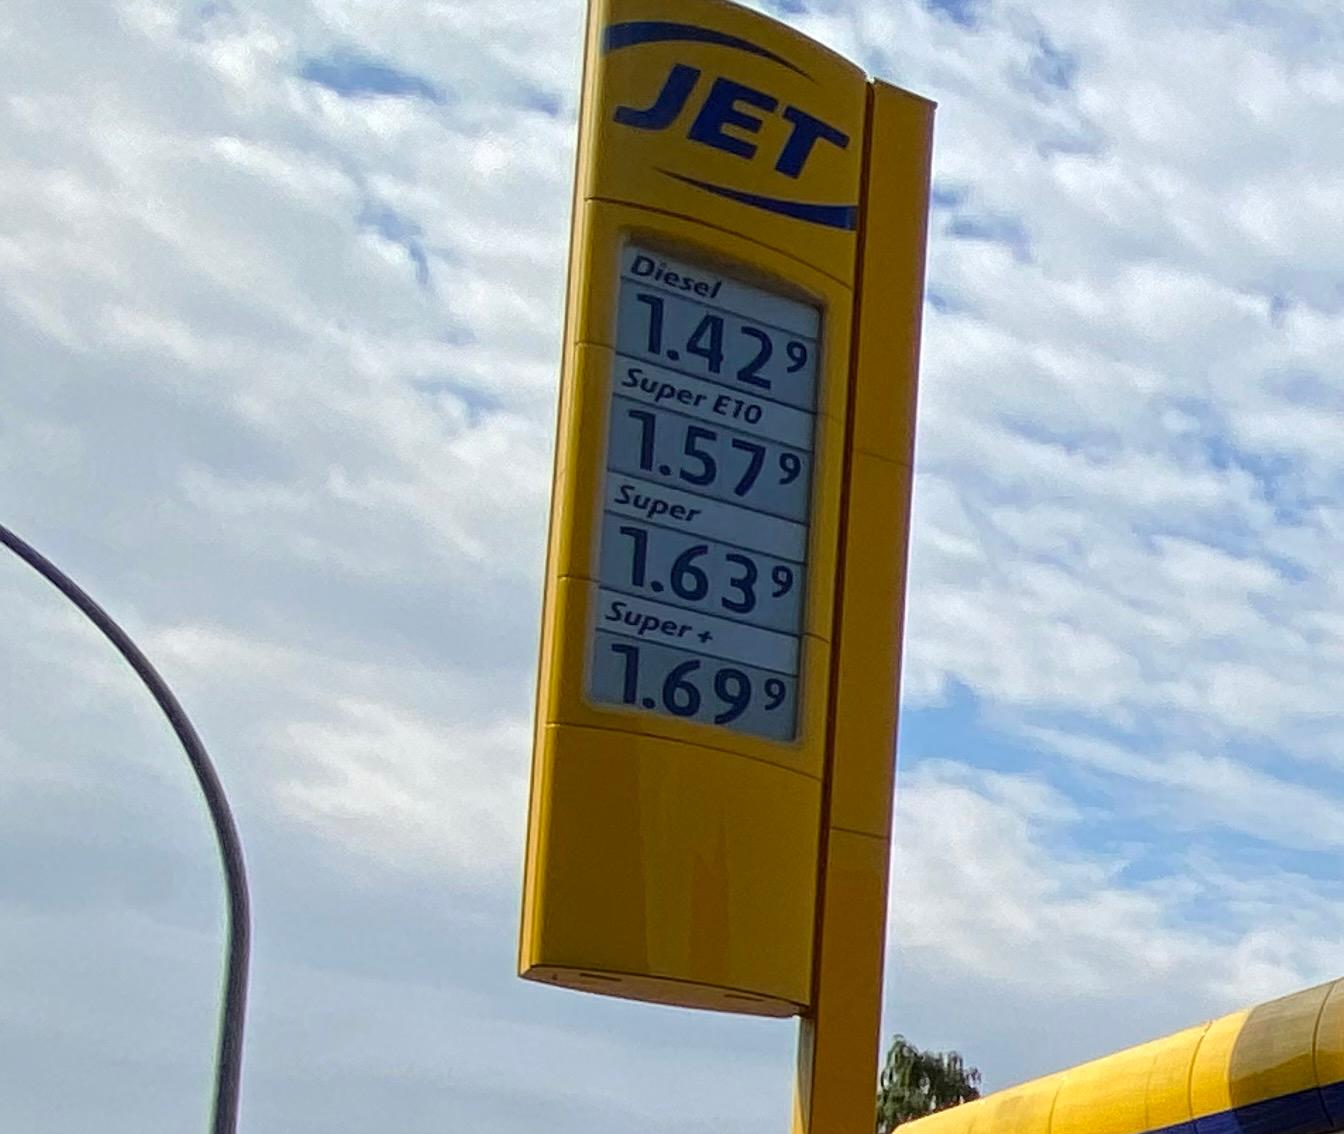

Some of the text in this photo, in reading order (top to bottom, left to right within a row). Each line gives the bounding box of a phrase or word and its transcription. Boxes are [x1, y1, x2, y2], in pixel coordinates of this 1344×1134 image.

[613, 63, 851, 179] JET
[630, 255, 722, 300] Diesel
[622, 367, 763, 425] Super E10
[614, 484, 702, 522] Super
[605, 602, 713, 644] Super +
